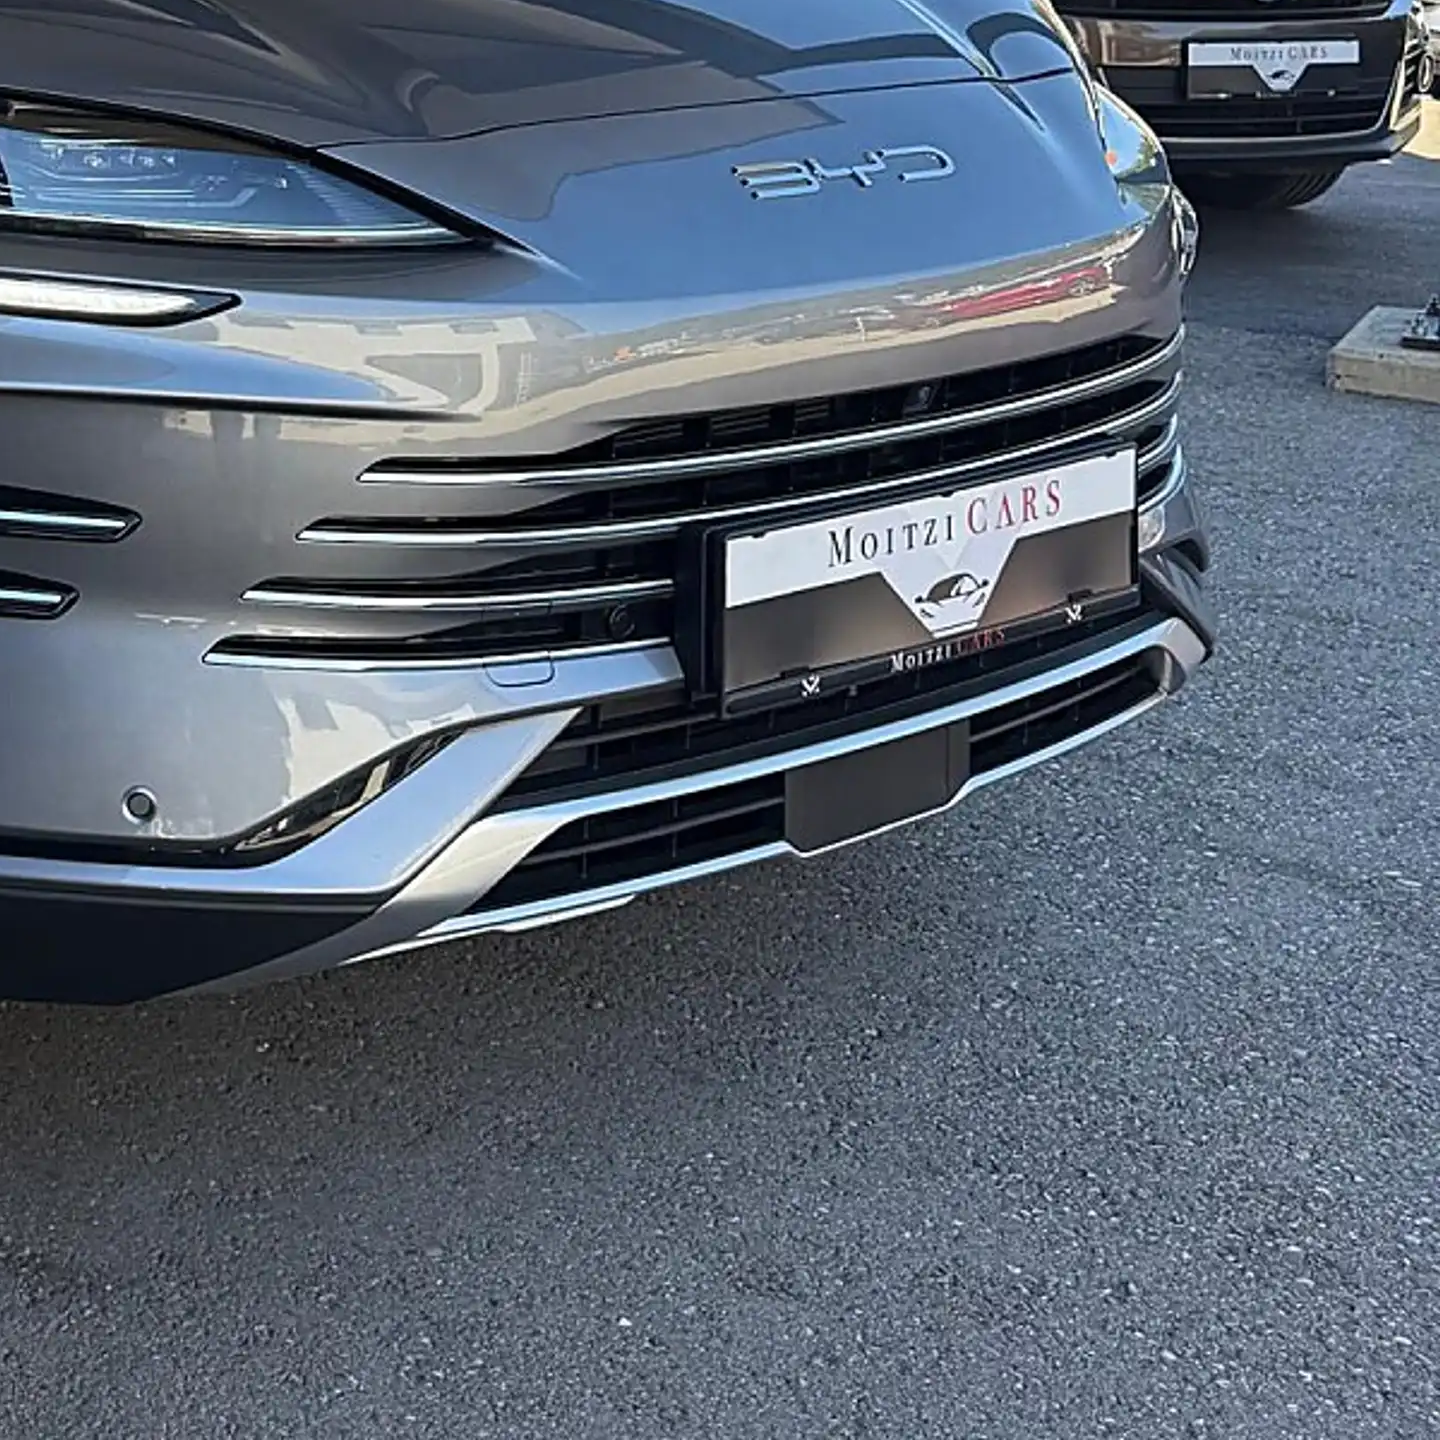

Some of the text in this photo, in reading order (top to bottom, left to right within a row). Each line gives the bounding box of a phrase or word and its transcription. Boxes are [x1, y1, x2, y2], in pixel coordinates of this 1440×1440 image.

[1287, 44, 1329, 60] CARS
[730, 143, 956, 200] BYD
[826, 479, 1064, 568] MOITZI CARS
